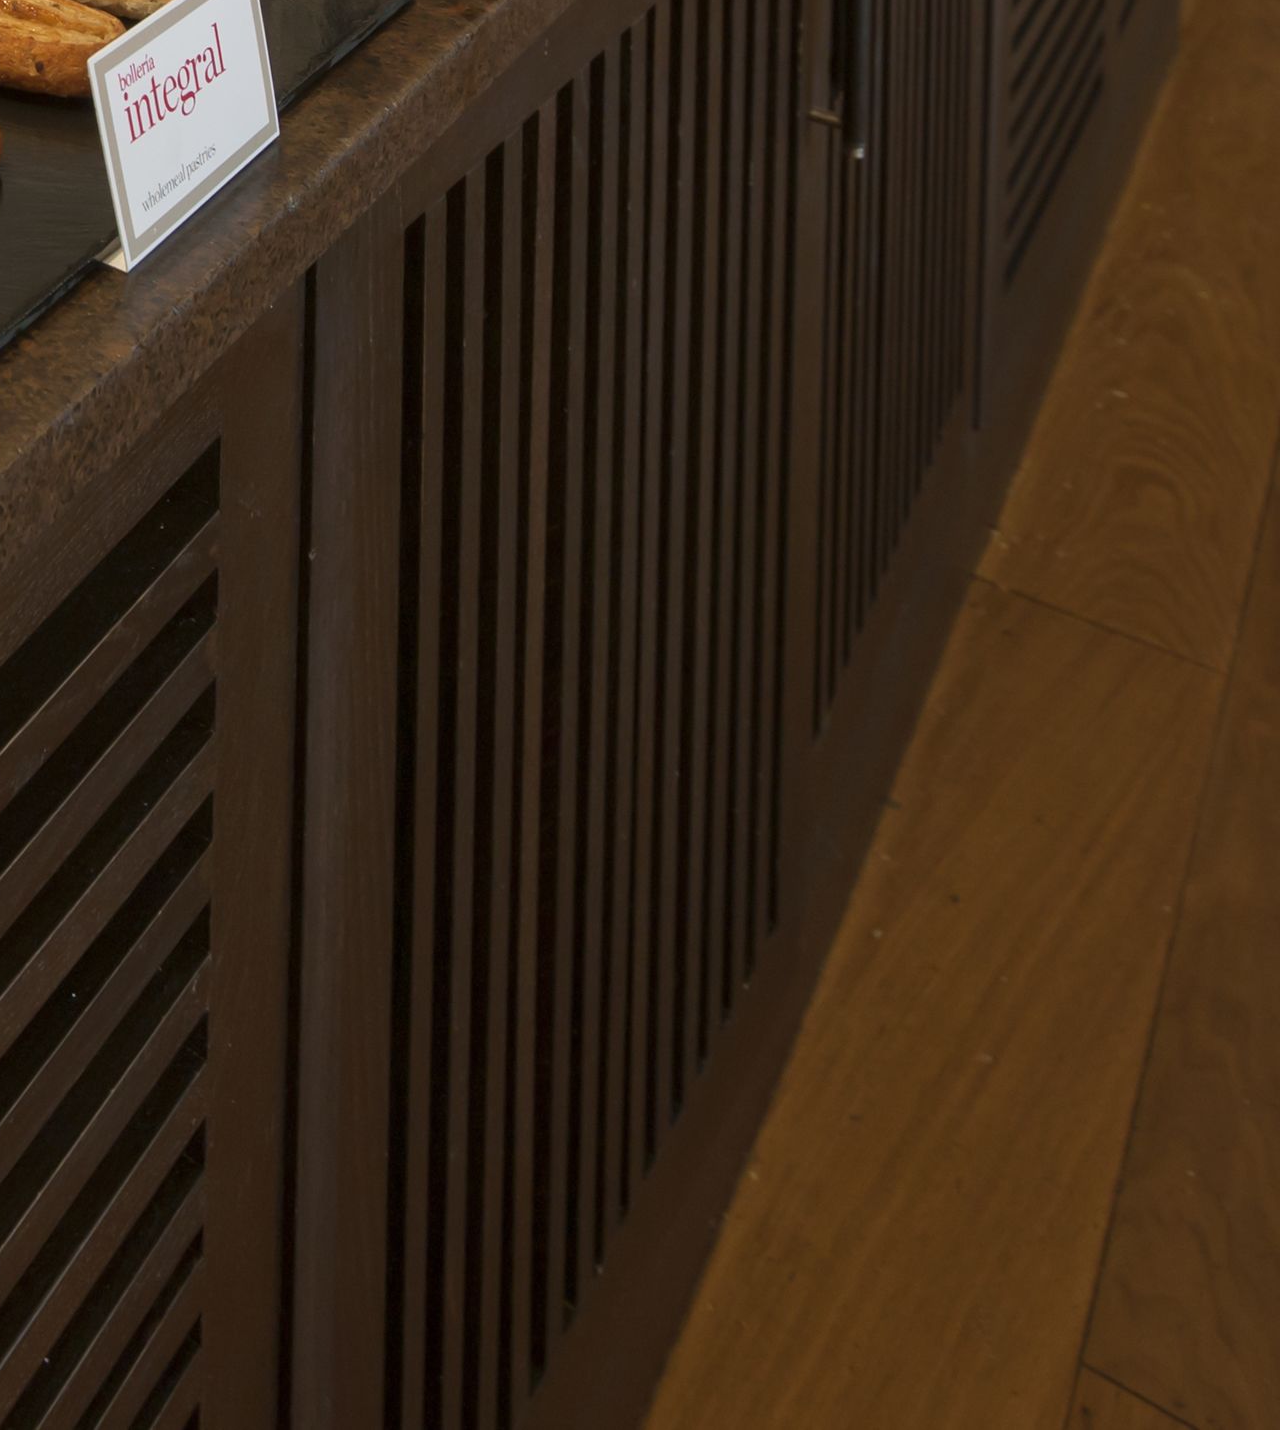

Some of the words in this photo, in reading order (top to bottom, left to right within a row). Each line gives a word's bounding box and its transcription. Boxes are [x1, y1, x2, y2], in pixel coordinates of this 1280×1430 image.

[117, 54, 156, 92] bollería
[124, 22, 227, 145] integral
[141, 162, 187, 213] wholemeal
[184, 144, 217, 182] pastries
